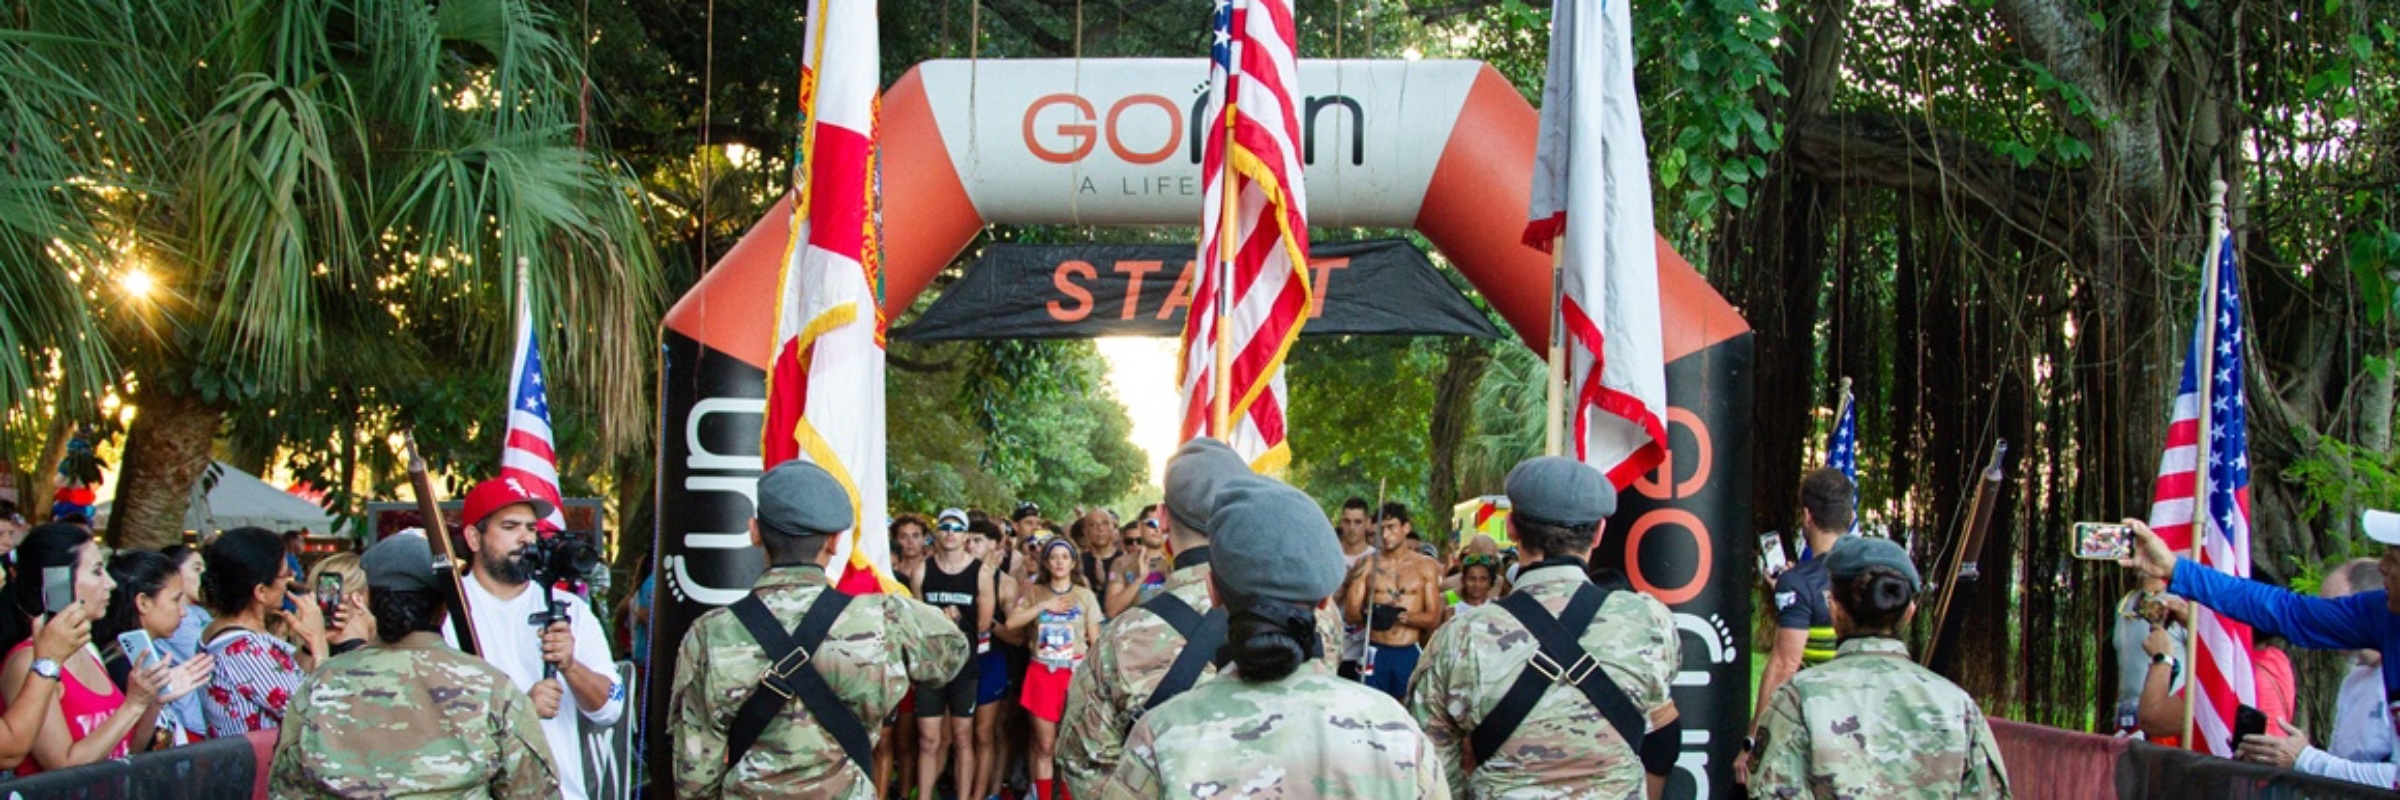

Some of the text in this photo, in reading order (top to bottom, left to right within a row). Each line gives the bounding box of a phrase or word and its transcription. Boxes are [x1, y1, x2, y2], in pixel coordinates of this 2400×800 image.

[1022, 88, 1364, 166] GOrn
[1080, 176, 1096, 195] A
[1046, 257, 1350, 322] STAT
[671, 397, 768, 605] run
